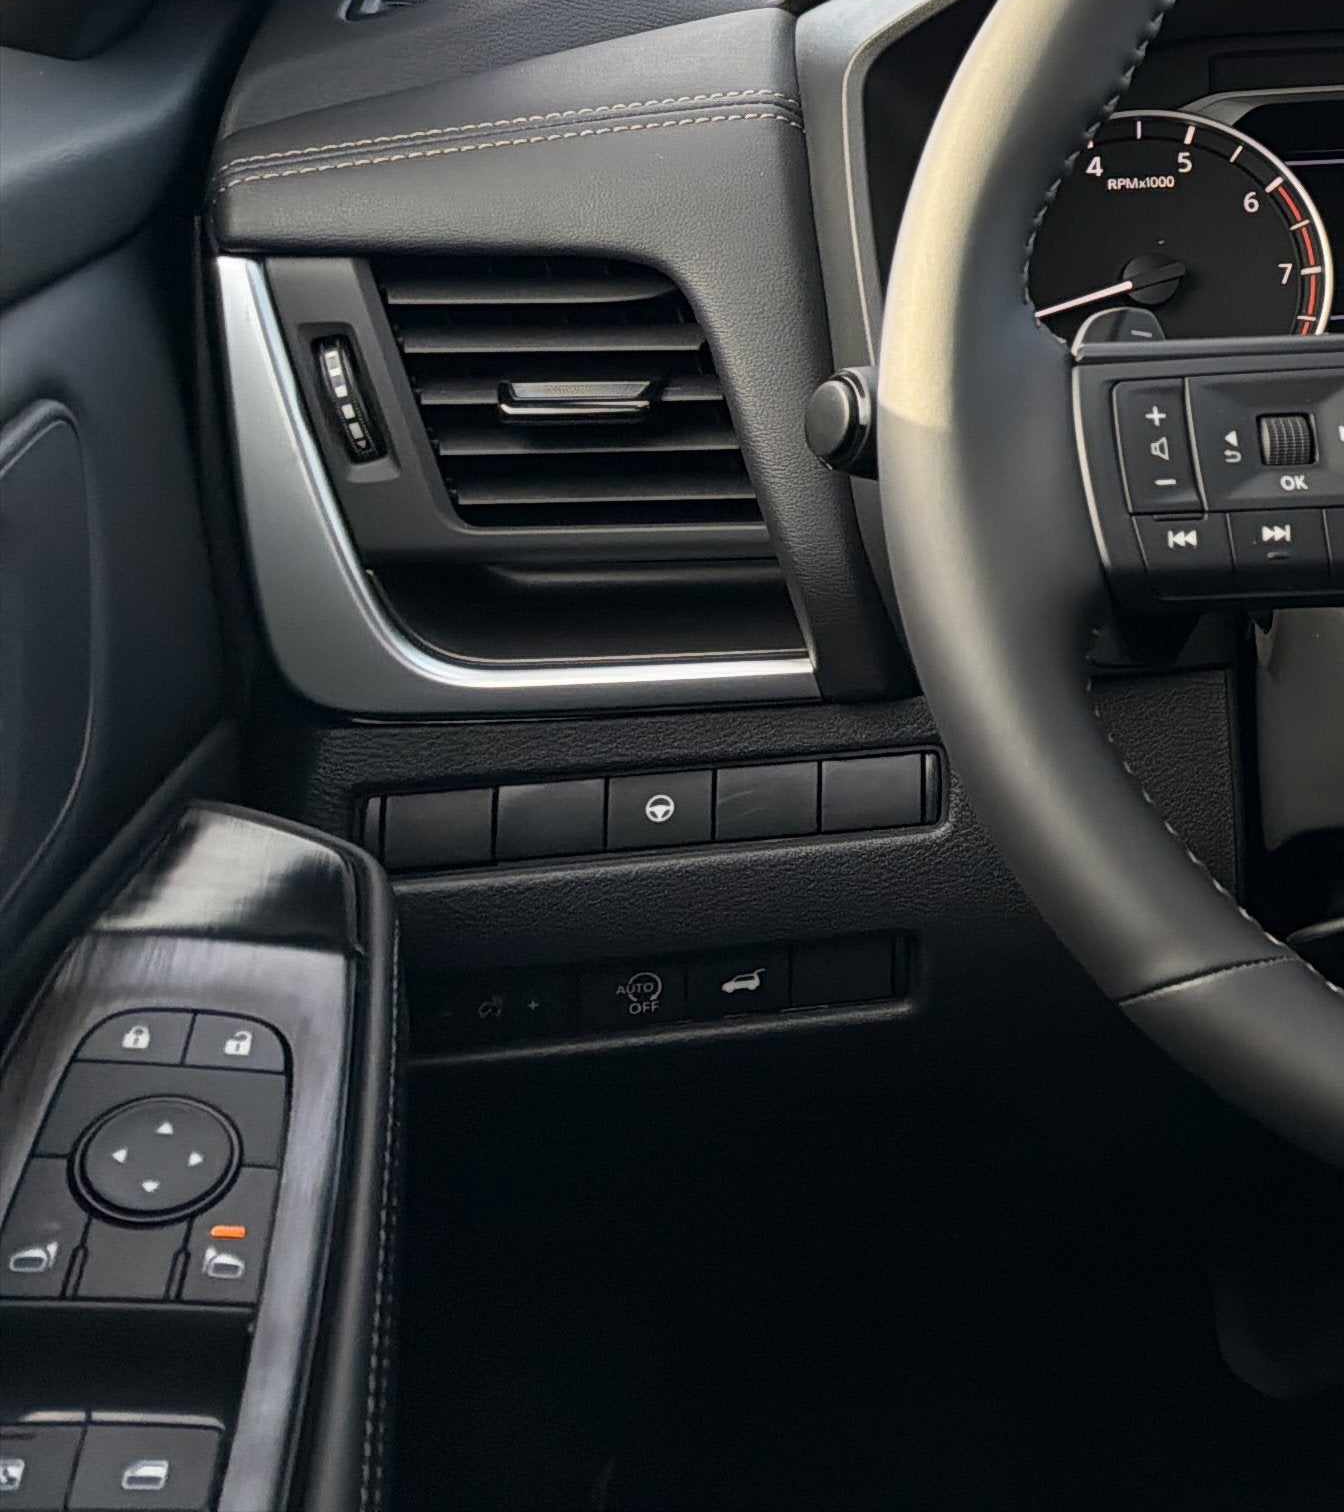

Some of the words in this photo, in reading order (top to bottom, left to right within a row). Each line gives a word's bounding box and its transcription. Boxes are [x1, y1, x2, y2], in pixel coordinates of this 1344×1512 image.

[1086, 156, 1104, 177] 4
[1177, 152, 1193, 173] 5
[1107, 175, 1175, 190] RPMx1000
[1243, 192, 1260, 213] 6
[1278, 263, 1293, 285] 7
[1280, 475, 1309, 492] OK
[616, 981, 655, 996] AUTO
[628, 1000, 660, 1015] OFF
